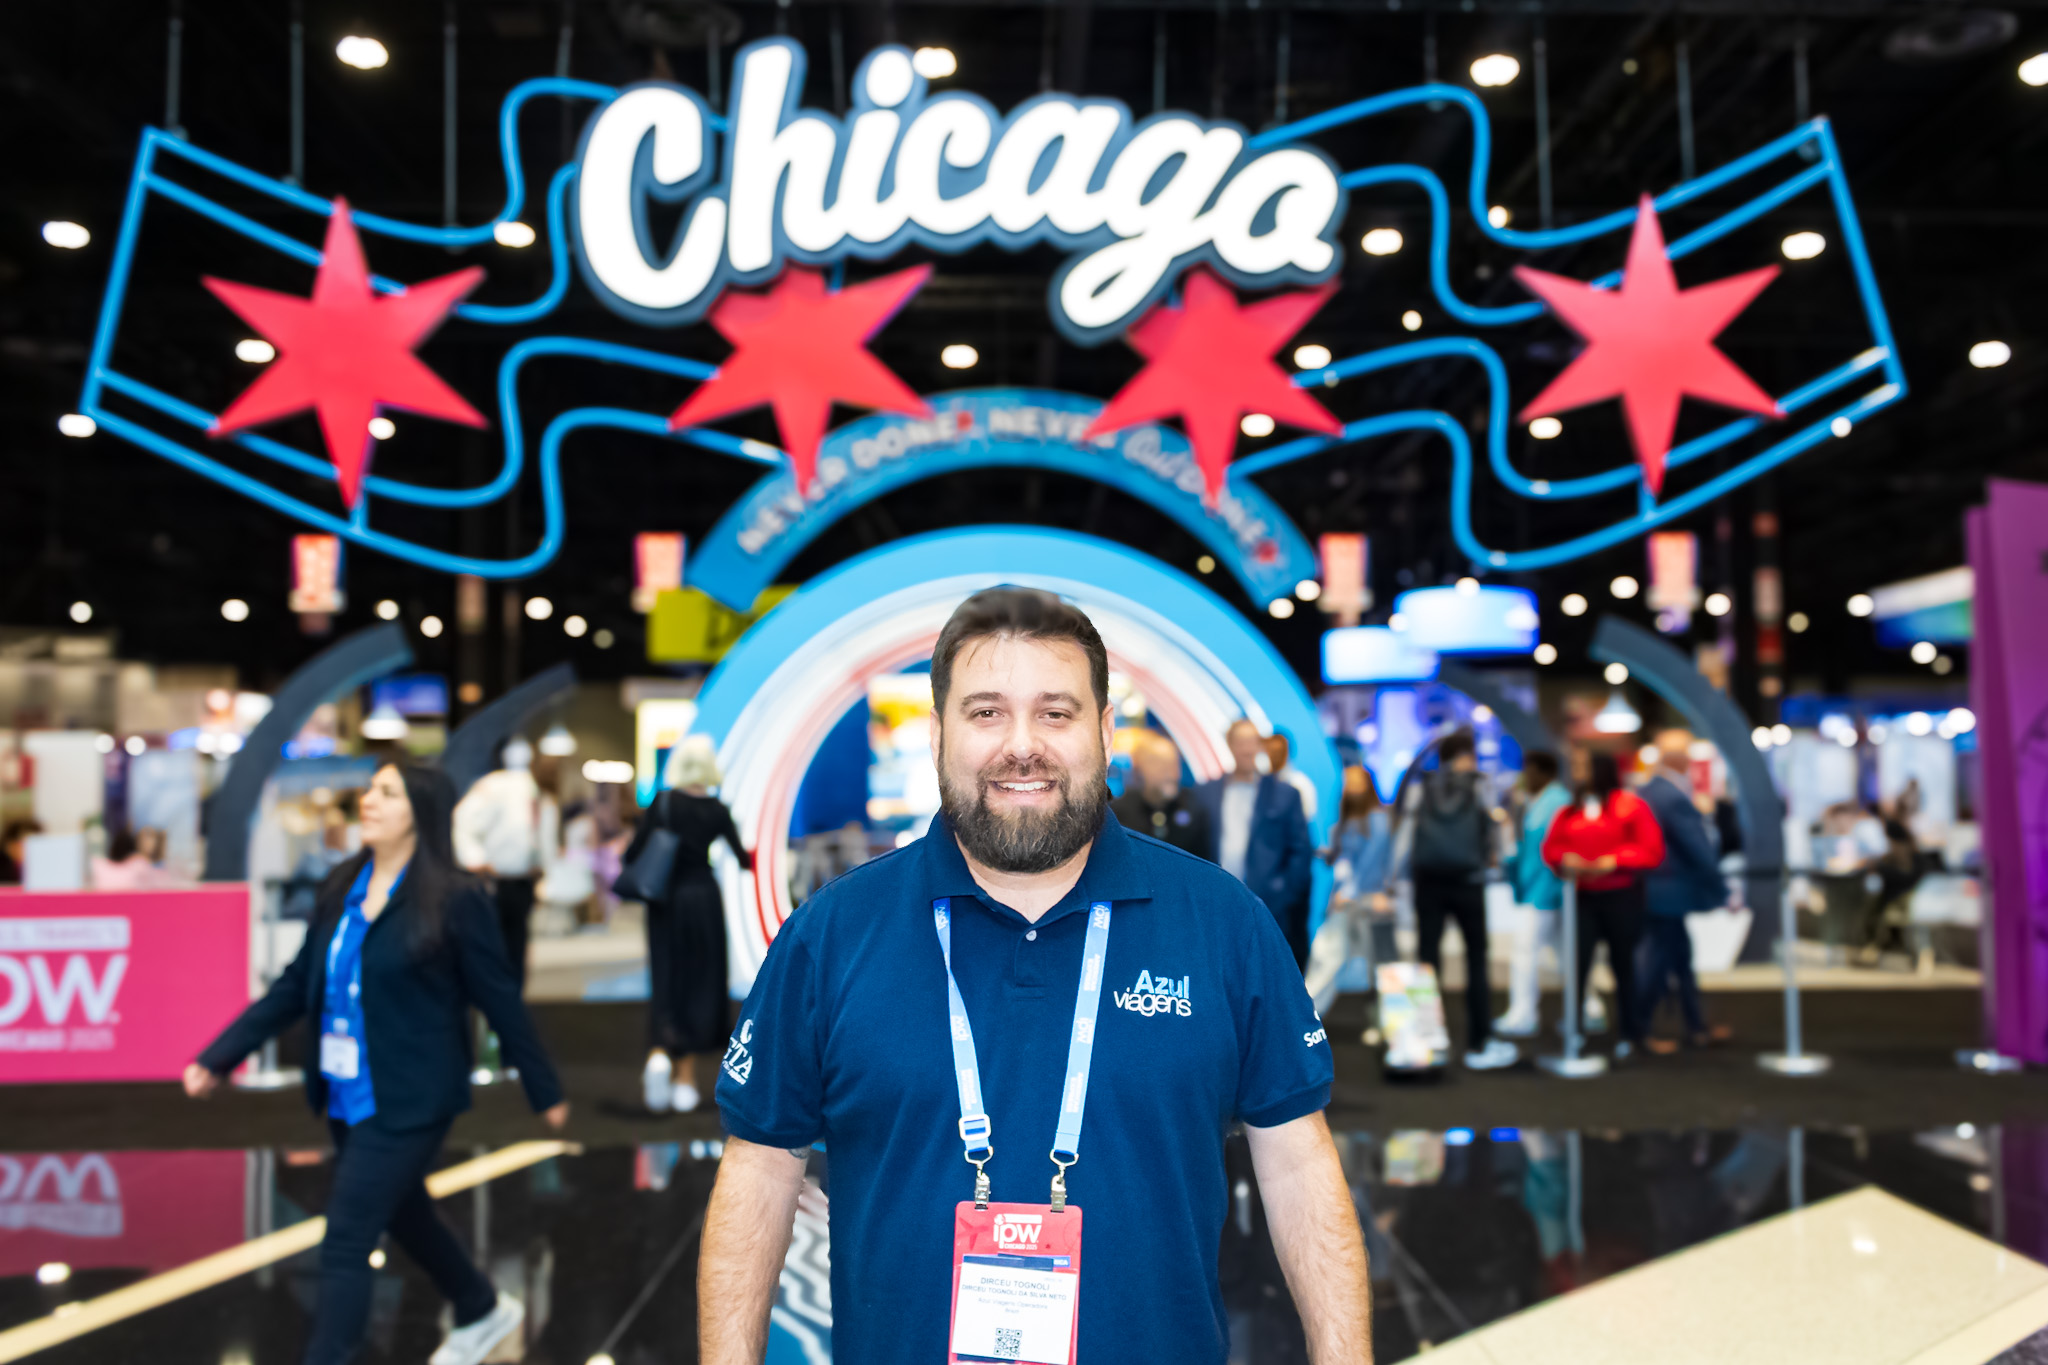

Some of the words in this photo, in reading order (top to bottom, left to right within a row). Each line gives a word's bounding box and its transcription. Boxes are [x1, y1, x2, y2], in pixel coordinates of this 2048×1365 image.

[576, 41, 1340, 330] Chicago
[1133, 969, 1190, 1000] Azul
[1113, 987, 1192, 1017] viagens
[993, 1214, 1042, 1249] ipw
[961, 1284, 986, 1293] DIRCEU
[988, 1287, 1017, 1296] TOGNOLI
[1029, 1291, 1047, 1299] SILVA
[980, 1277, 1011, 1287] DIRCEU
[1014, 1280, 1050, 1291] TOGNOLI
